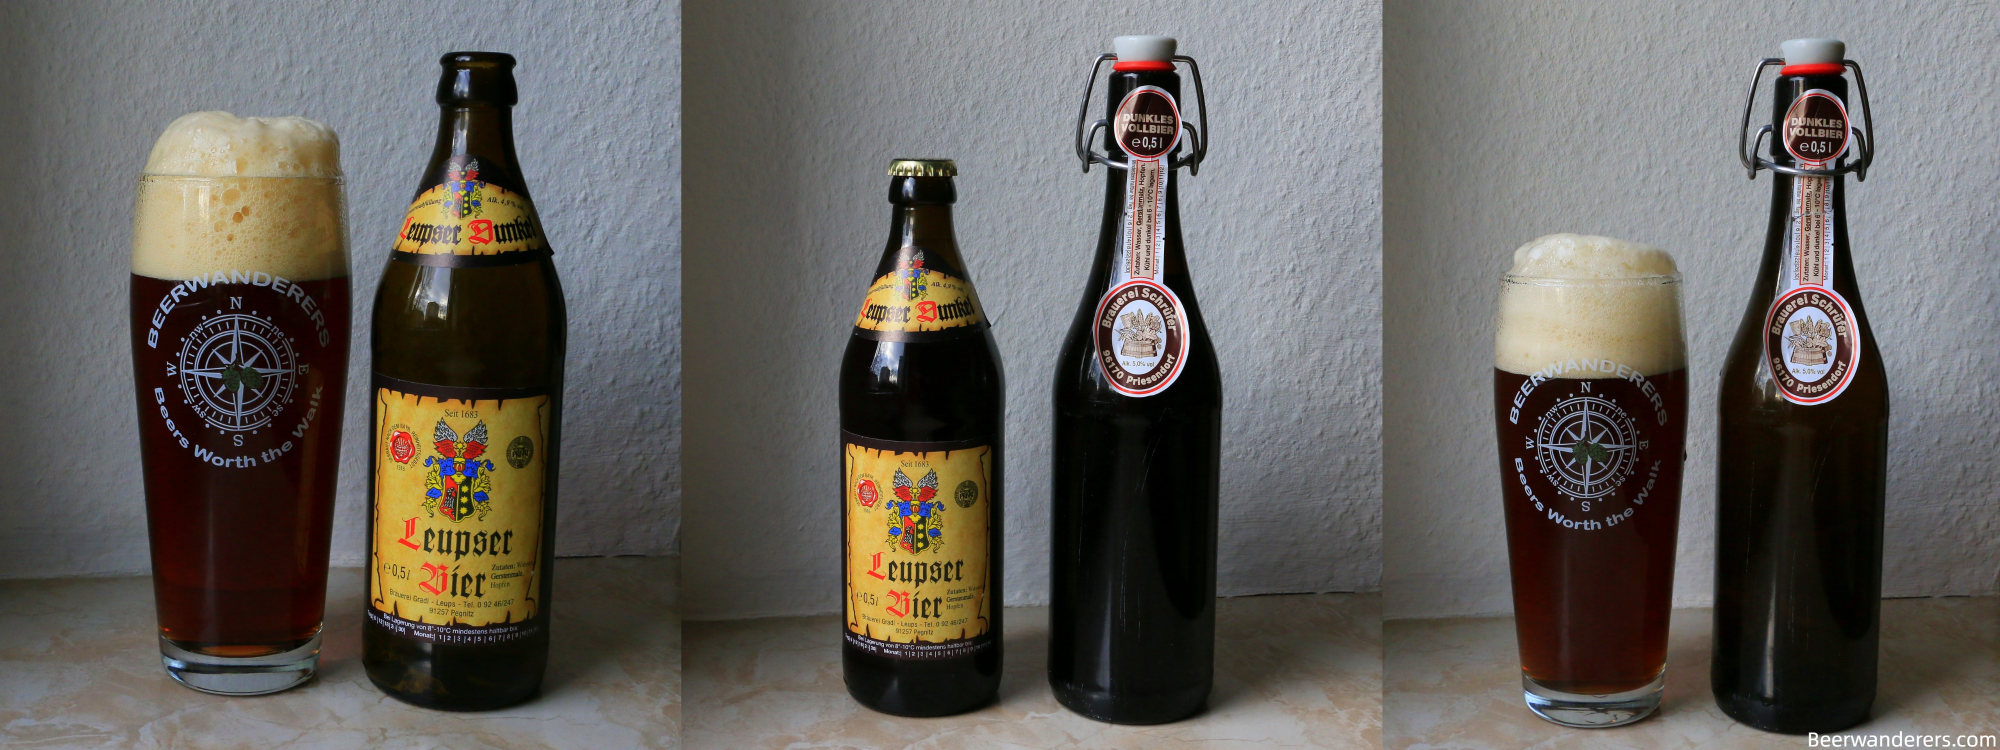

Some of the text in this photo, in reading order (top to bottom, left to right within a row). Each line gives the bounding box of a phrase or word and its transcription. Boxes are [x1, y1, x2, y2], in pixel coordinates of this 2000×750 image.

[1122, 114, 1174, 124] DUNKLES
[1792, 117, 1842, 128] DUNKLES
[1121, 124, 1174, 135] VOLLBIER
[1790, 128, 1843, 139] VOLLBIER
[400, 215, 536, 247] Leupser Dunkel
[148, 270, 330, 348] BEERWANDERERS
[230, 296, 242, 310] N
[860, 295, 975, 324] Leupser Dunkel
[1102, 287, 1177, 331] Brauerei Schrüfer
[1771, 294, 1847, 338] Brauerei Schrüfer
[189, 324, 204, 340] nw
[271, 326, 284, 339] ne
[166, 362, 177, 376] W
[1103, 350, 1176, 386] 96170 Priesendorf
[1773, 357, 1846, 393] 96170 Priesendorf
[1510, 358, 1668, 426] BEERWANDERERS
[1580, 382, 1591, 393] N
[444, 408, 478, 418] Seit 1683
[1545, 404, 1558, 418] nw
[1615, 407, 1627, 418] ne
[154, 385, 323, 468] Beers Worth the Walk
[233, 434, 244, 447] S
[1526, 436, 1535, 449] W
[1515, 458, 1661, 530] Beers Worth the Walk
[1582, 501, 1591, 512] S
[397, 516, 513, 562] Leupser
[866, 552, 964, 588] Leupser
[418, 561, 486, 599] Bier
[390, 588, 412, 600] Brauerei
[436, 599, 456, 608] Leups
[886, 589, 942, 620] Bier
[392, 616, 416, 629] Lagerung
